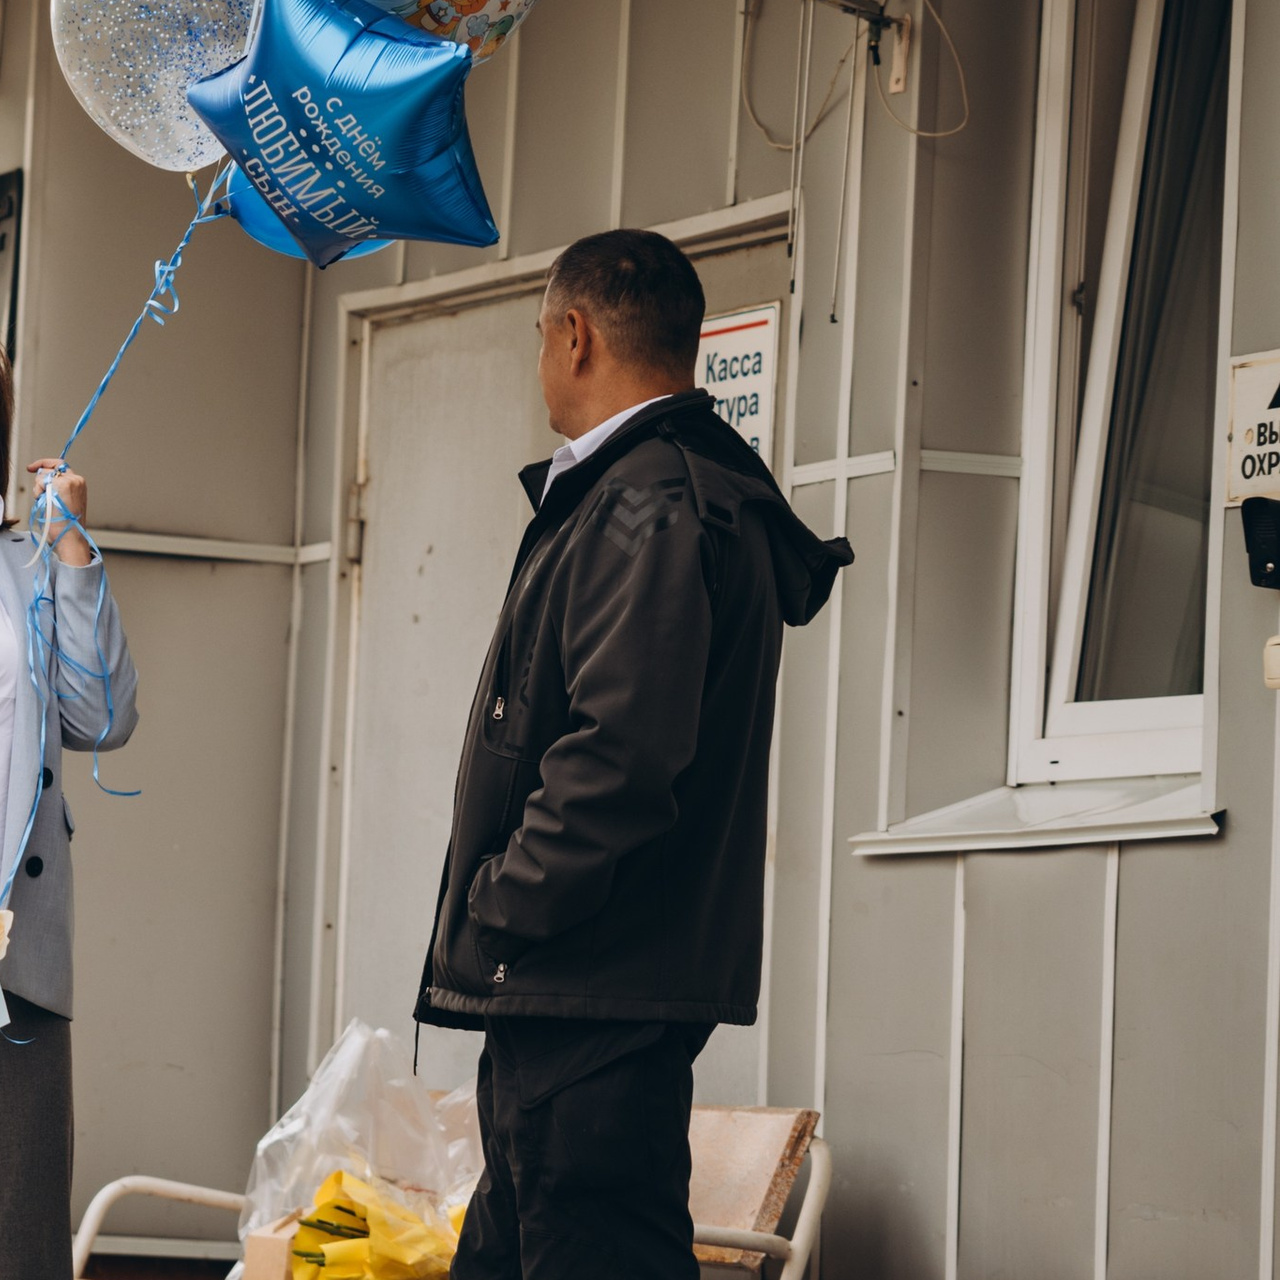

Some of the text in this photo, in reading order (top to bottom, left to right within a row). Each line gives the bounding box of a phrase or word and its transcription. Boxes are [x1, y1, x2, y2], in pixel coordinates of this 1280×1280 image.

[291, 86, 385, 199] рождения
[334, 113, 386, 171] днём
[706, 350, 762, 384] Касса
[715, 391, 759, 427] тура
[1241, 451, 1280, 480] ОХР
